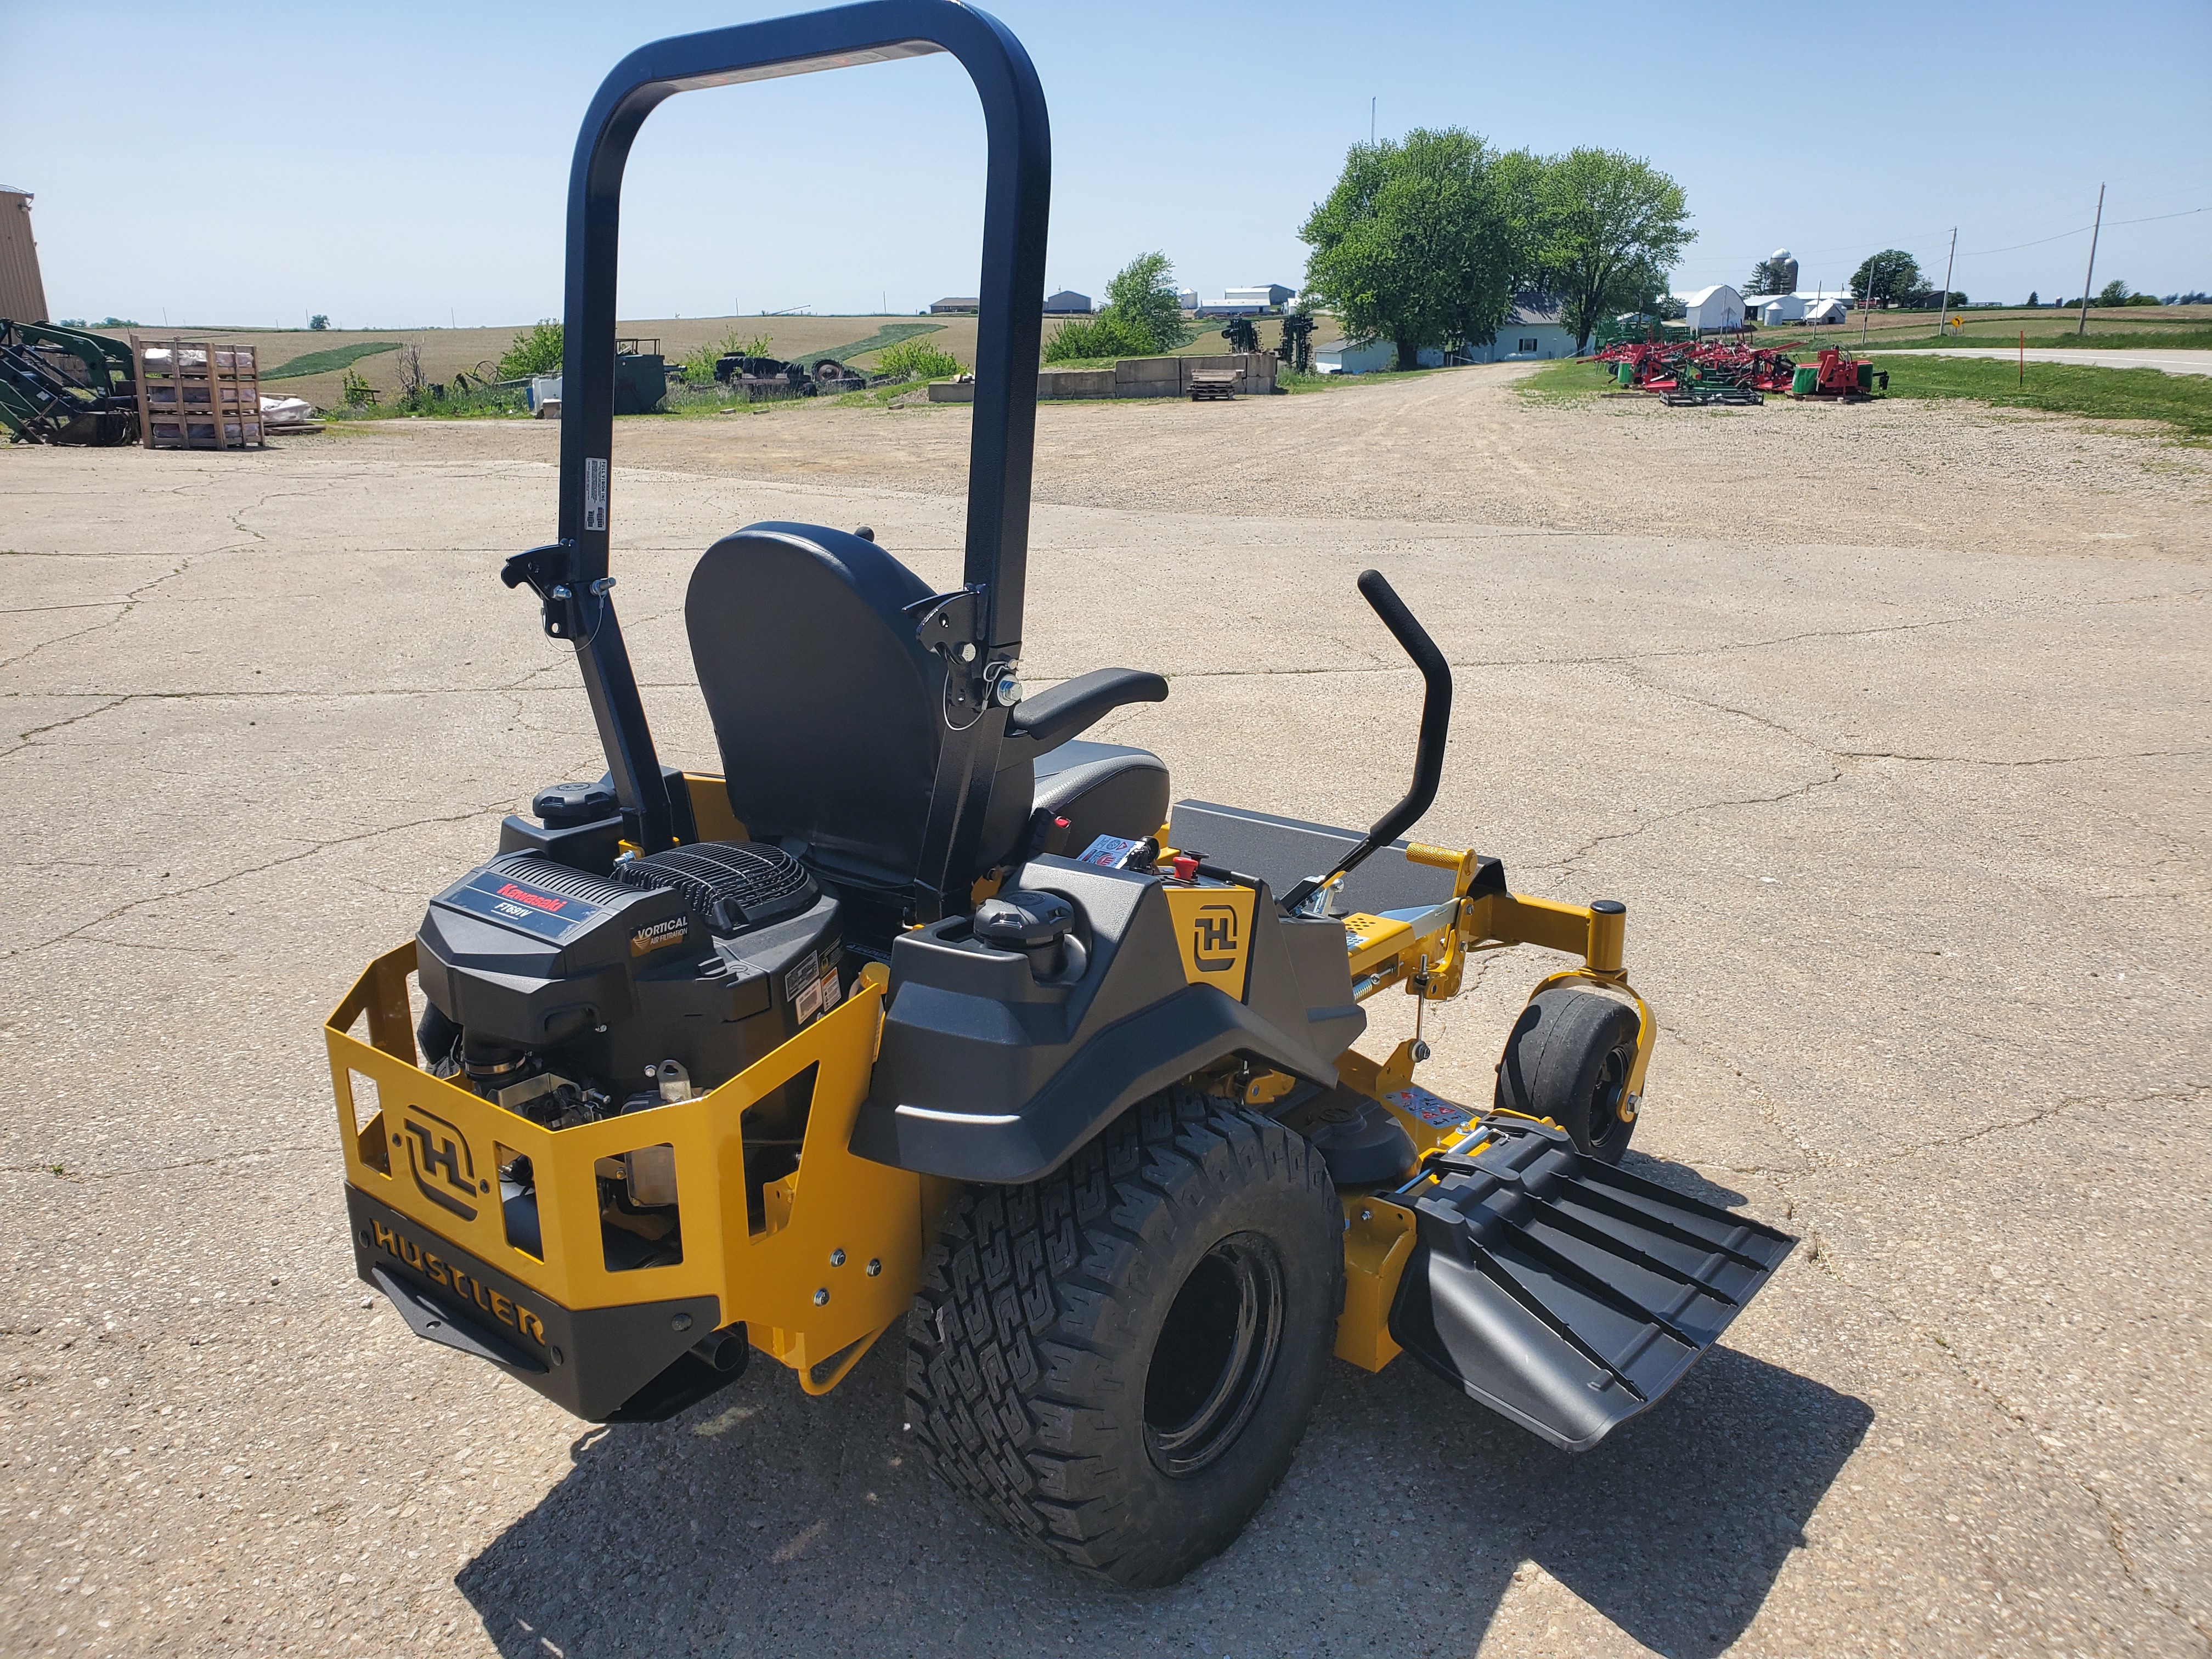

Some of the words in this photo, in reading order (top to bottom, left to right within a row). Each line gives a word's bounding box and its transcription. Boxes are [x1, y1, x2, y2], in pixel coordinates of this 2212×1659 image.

[496, 883, 568, 912] Kawasaki
[494, 902, 533, 917] FT691V
[638, 916, 688, 939] VORTICAL
[650, 936, 659, 945] AIR
[660, 927, 688, 942] FILTRATION
[370, 1218, 545, 1346] HUSTLER
